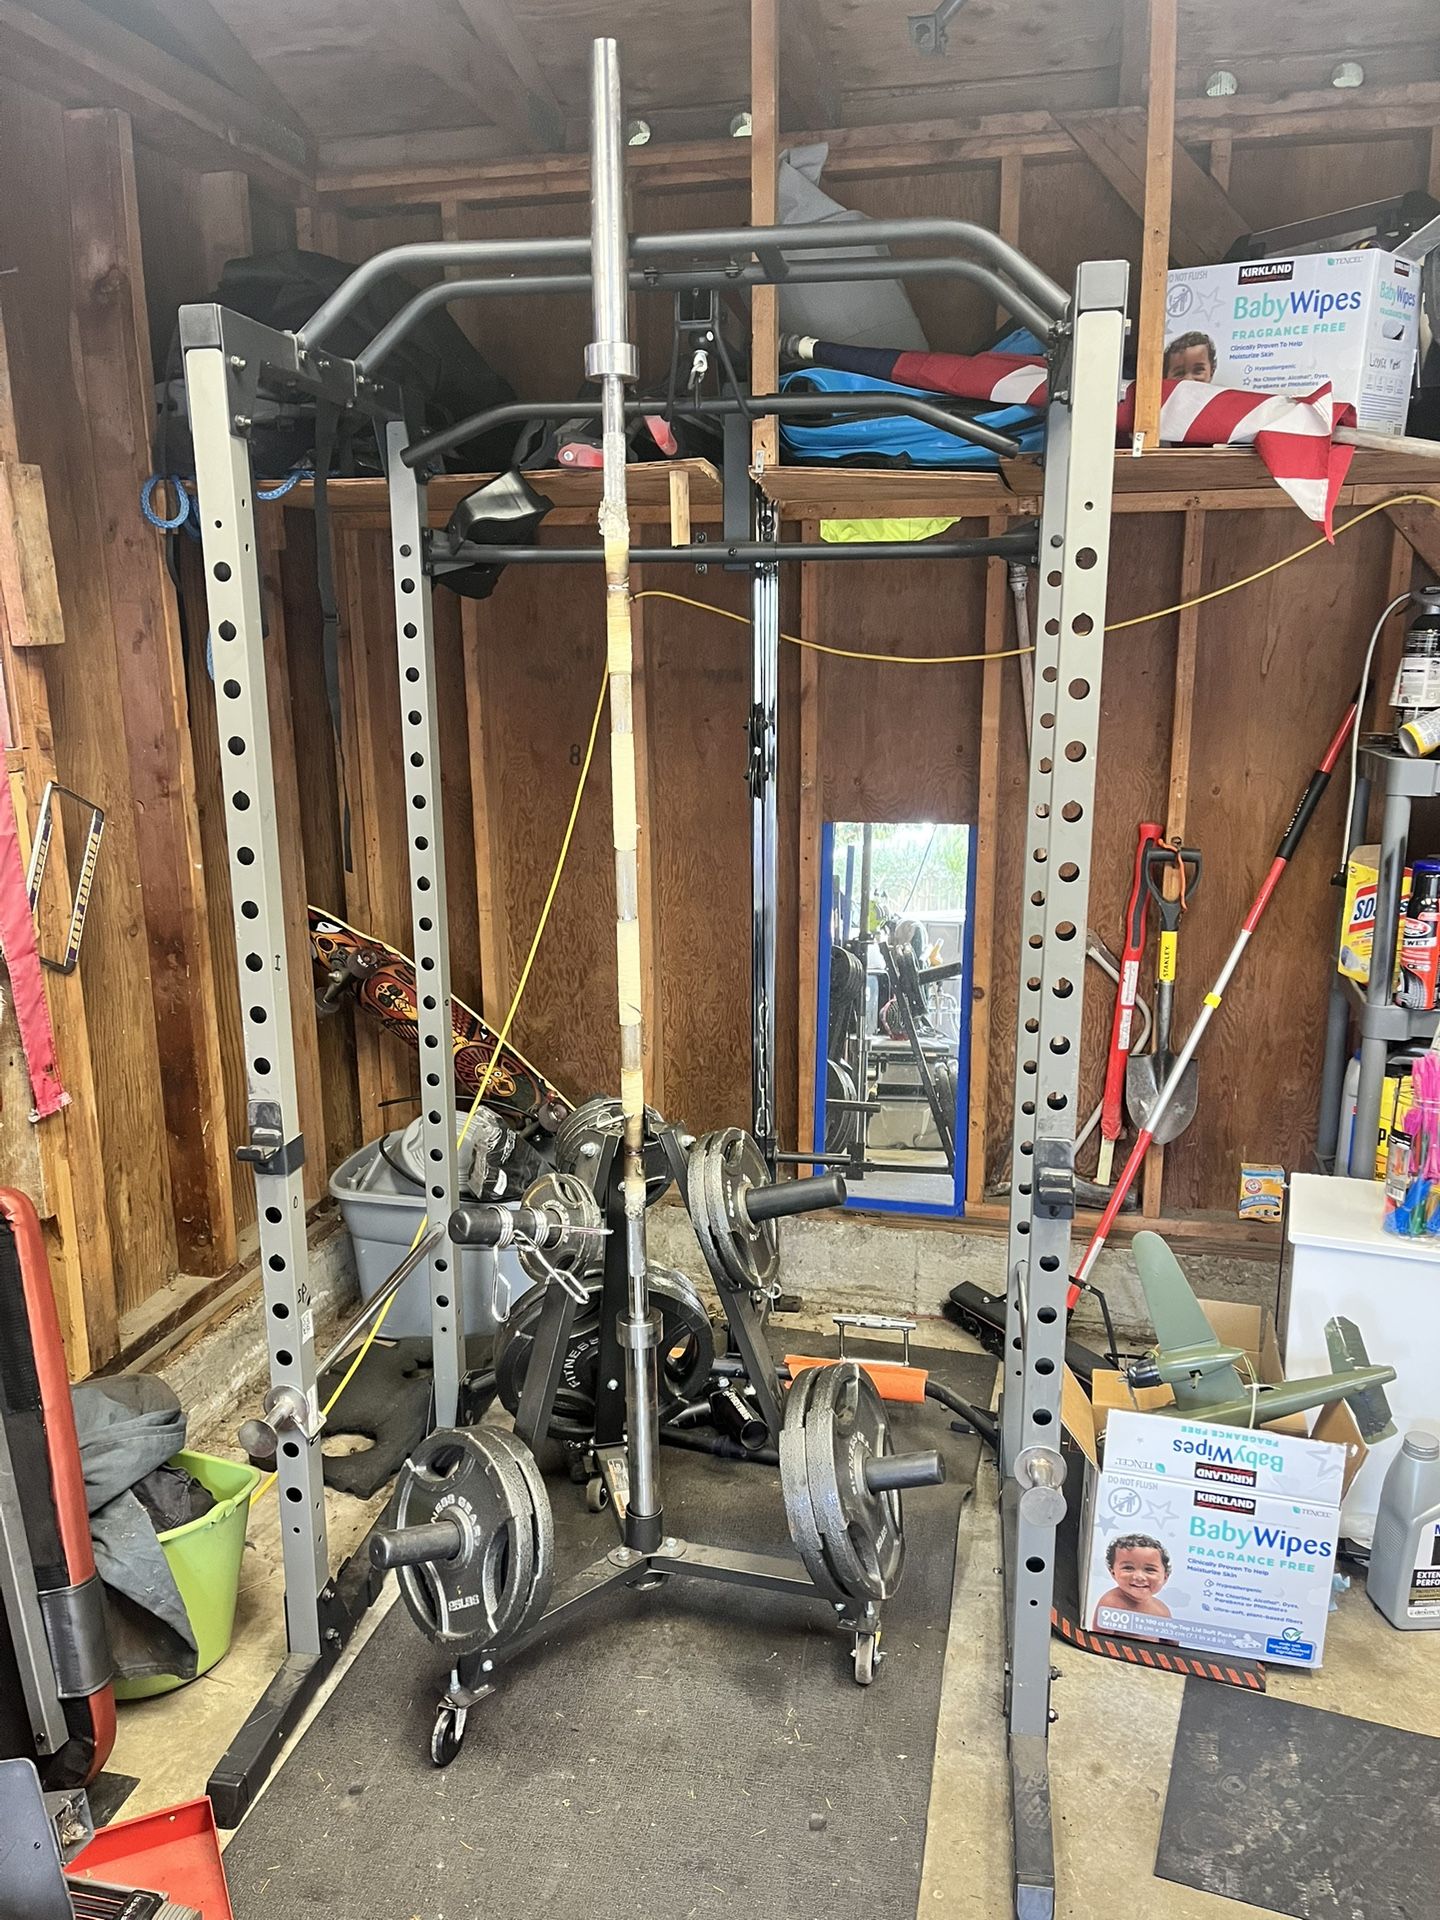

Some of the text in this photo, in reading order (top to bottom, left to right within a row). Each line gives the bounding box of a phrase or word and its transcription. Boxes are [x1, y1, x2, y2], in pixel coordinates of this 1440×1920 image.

[1187, 270, 1209, 281] FLUSH
[1241, 264, 1292, 278] KIRKLAND
[1232, 322, 1347, 340] FRAGRANCE FREE
[1230, 344, 1256, 352] Clinically
[1257, 342, 1279, 350] Proven
[1229, 352, 1259, 360] Moisturize
[570, 744, 581, 766] 8
[1162, 946, 1170, 977] STANLEY
[1181, 1425, 1280, 1448] FRAGRANCE FREE
[1107, 1475, 1159, 1490] DO NOT FLUSH
[1196, 1468, 1254, 1485] KIRKLAND
[1197, 1491, 1255, 1510] KIRKLAND
[1187, 1558, 1217, 1568] Clinically
[1218, 1563, 1243, 1572] Proven
[1253, 1568, 1270, 1576] Help
[1188, 1545, 1316, 1573] FRAGRANCE FREE
[1187, 1565, 1238, 1578] Moisturize Skin
[1101, 1609, 1130, 1625] 900
[1102, 1620, 1128, 1630] WIPES
